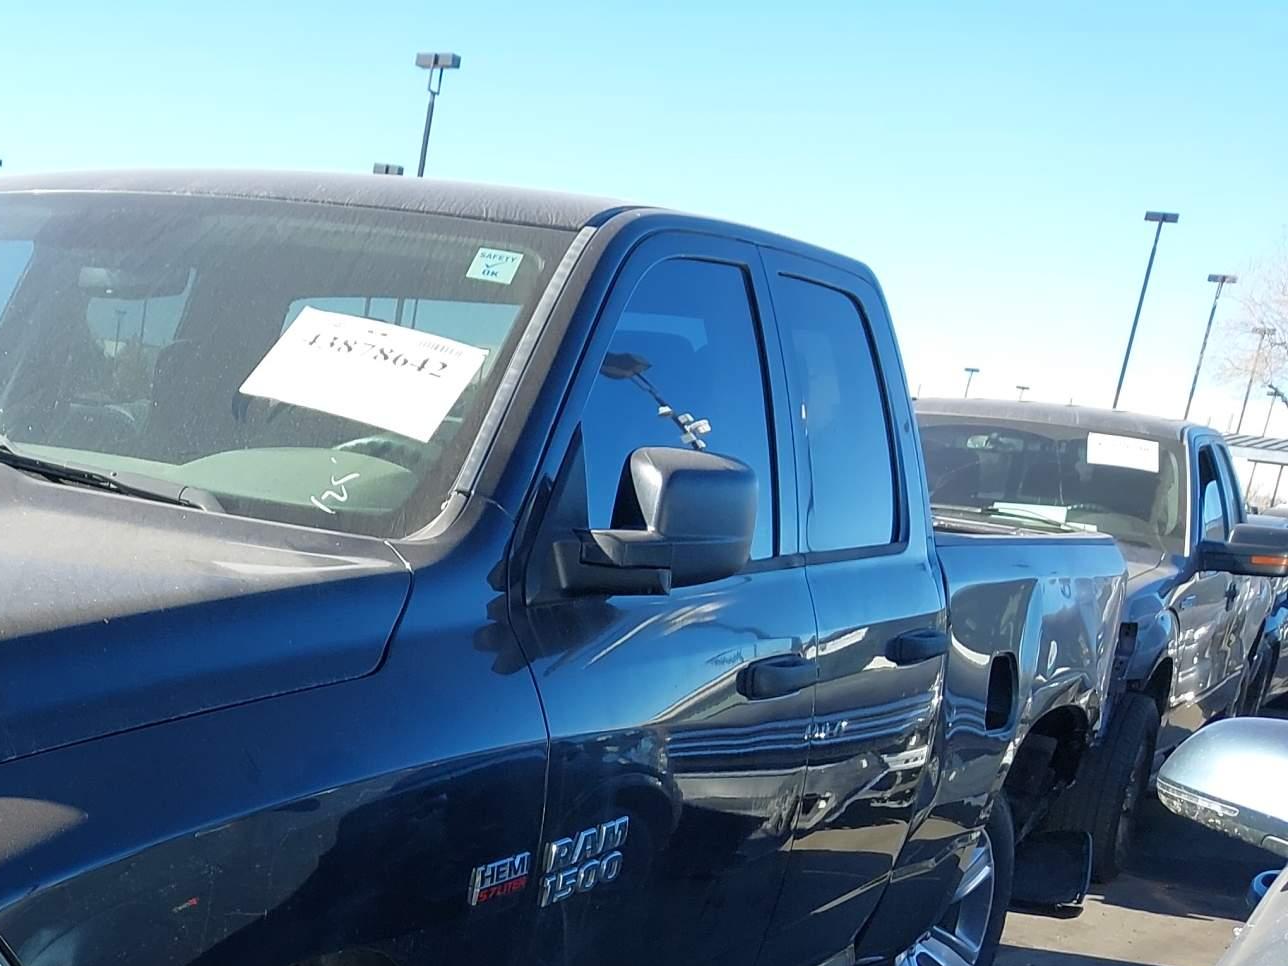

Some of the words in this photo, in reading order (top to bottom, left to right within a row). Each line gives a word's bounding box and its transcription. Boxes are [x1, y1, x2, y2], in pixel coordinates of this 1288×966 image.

[479, 252, 517, 263] SAFETY
[481, 269, 499, 277] OK
[543, 815, 629, 874] RAM
[470, 851, 531, 899] HEMI
[539, 850, 623, 908] 1500
